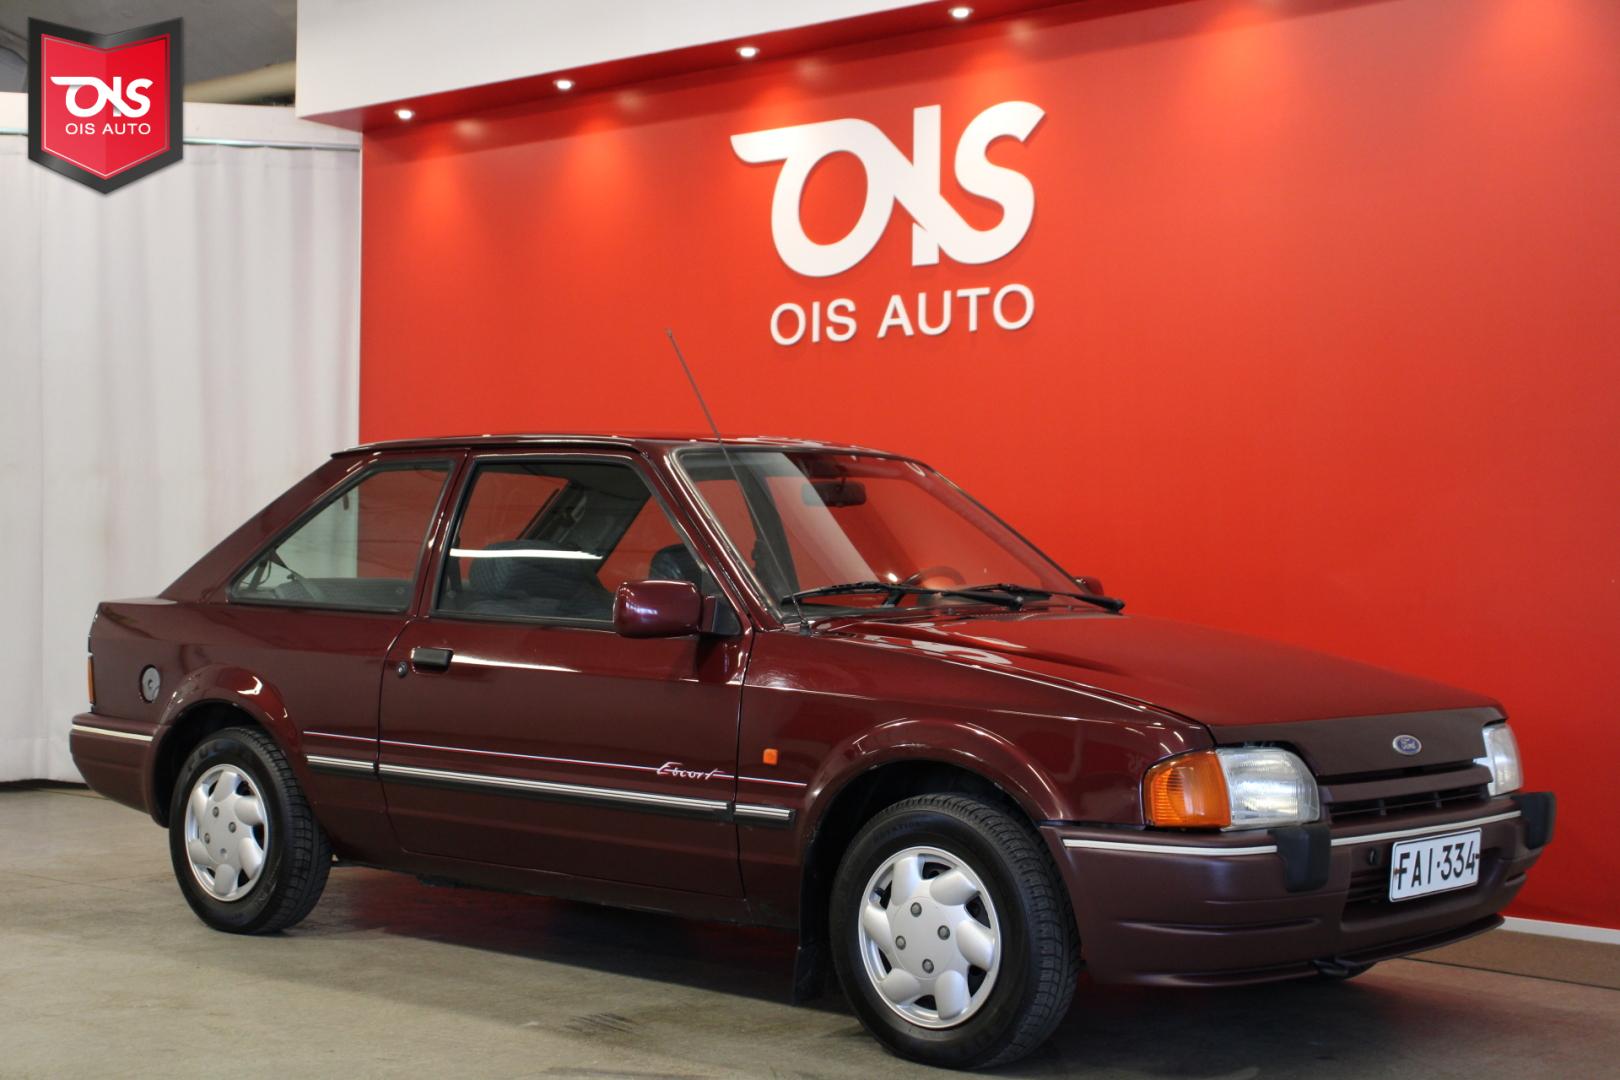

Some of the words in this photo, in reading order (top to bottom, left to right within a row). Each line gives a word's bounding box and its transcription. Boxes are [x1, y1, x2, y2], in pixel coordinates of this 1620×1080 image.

[770, 298, 857, 346] OIS
[877, 283, 1035, 338] AUTO
[1399, 737, 1418, 751] Ford
[656, 761, 725, 780] Escort
[1397, 840, 1476, 890] FAI-334
